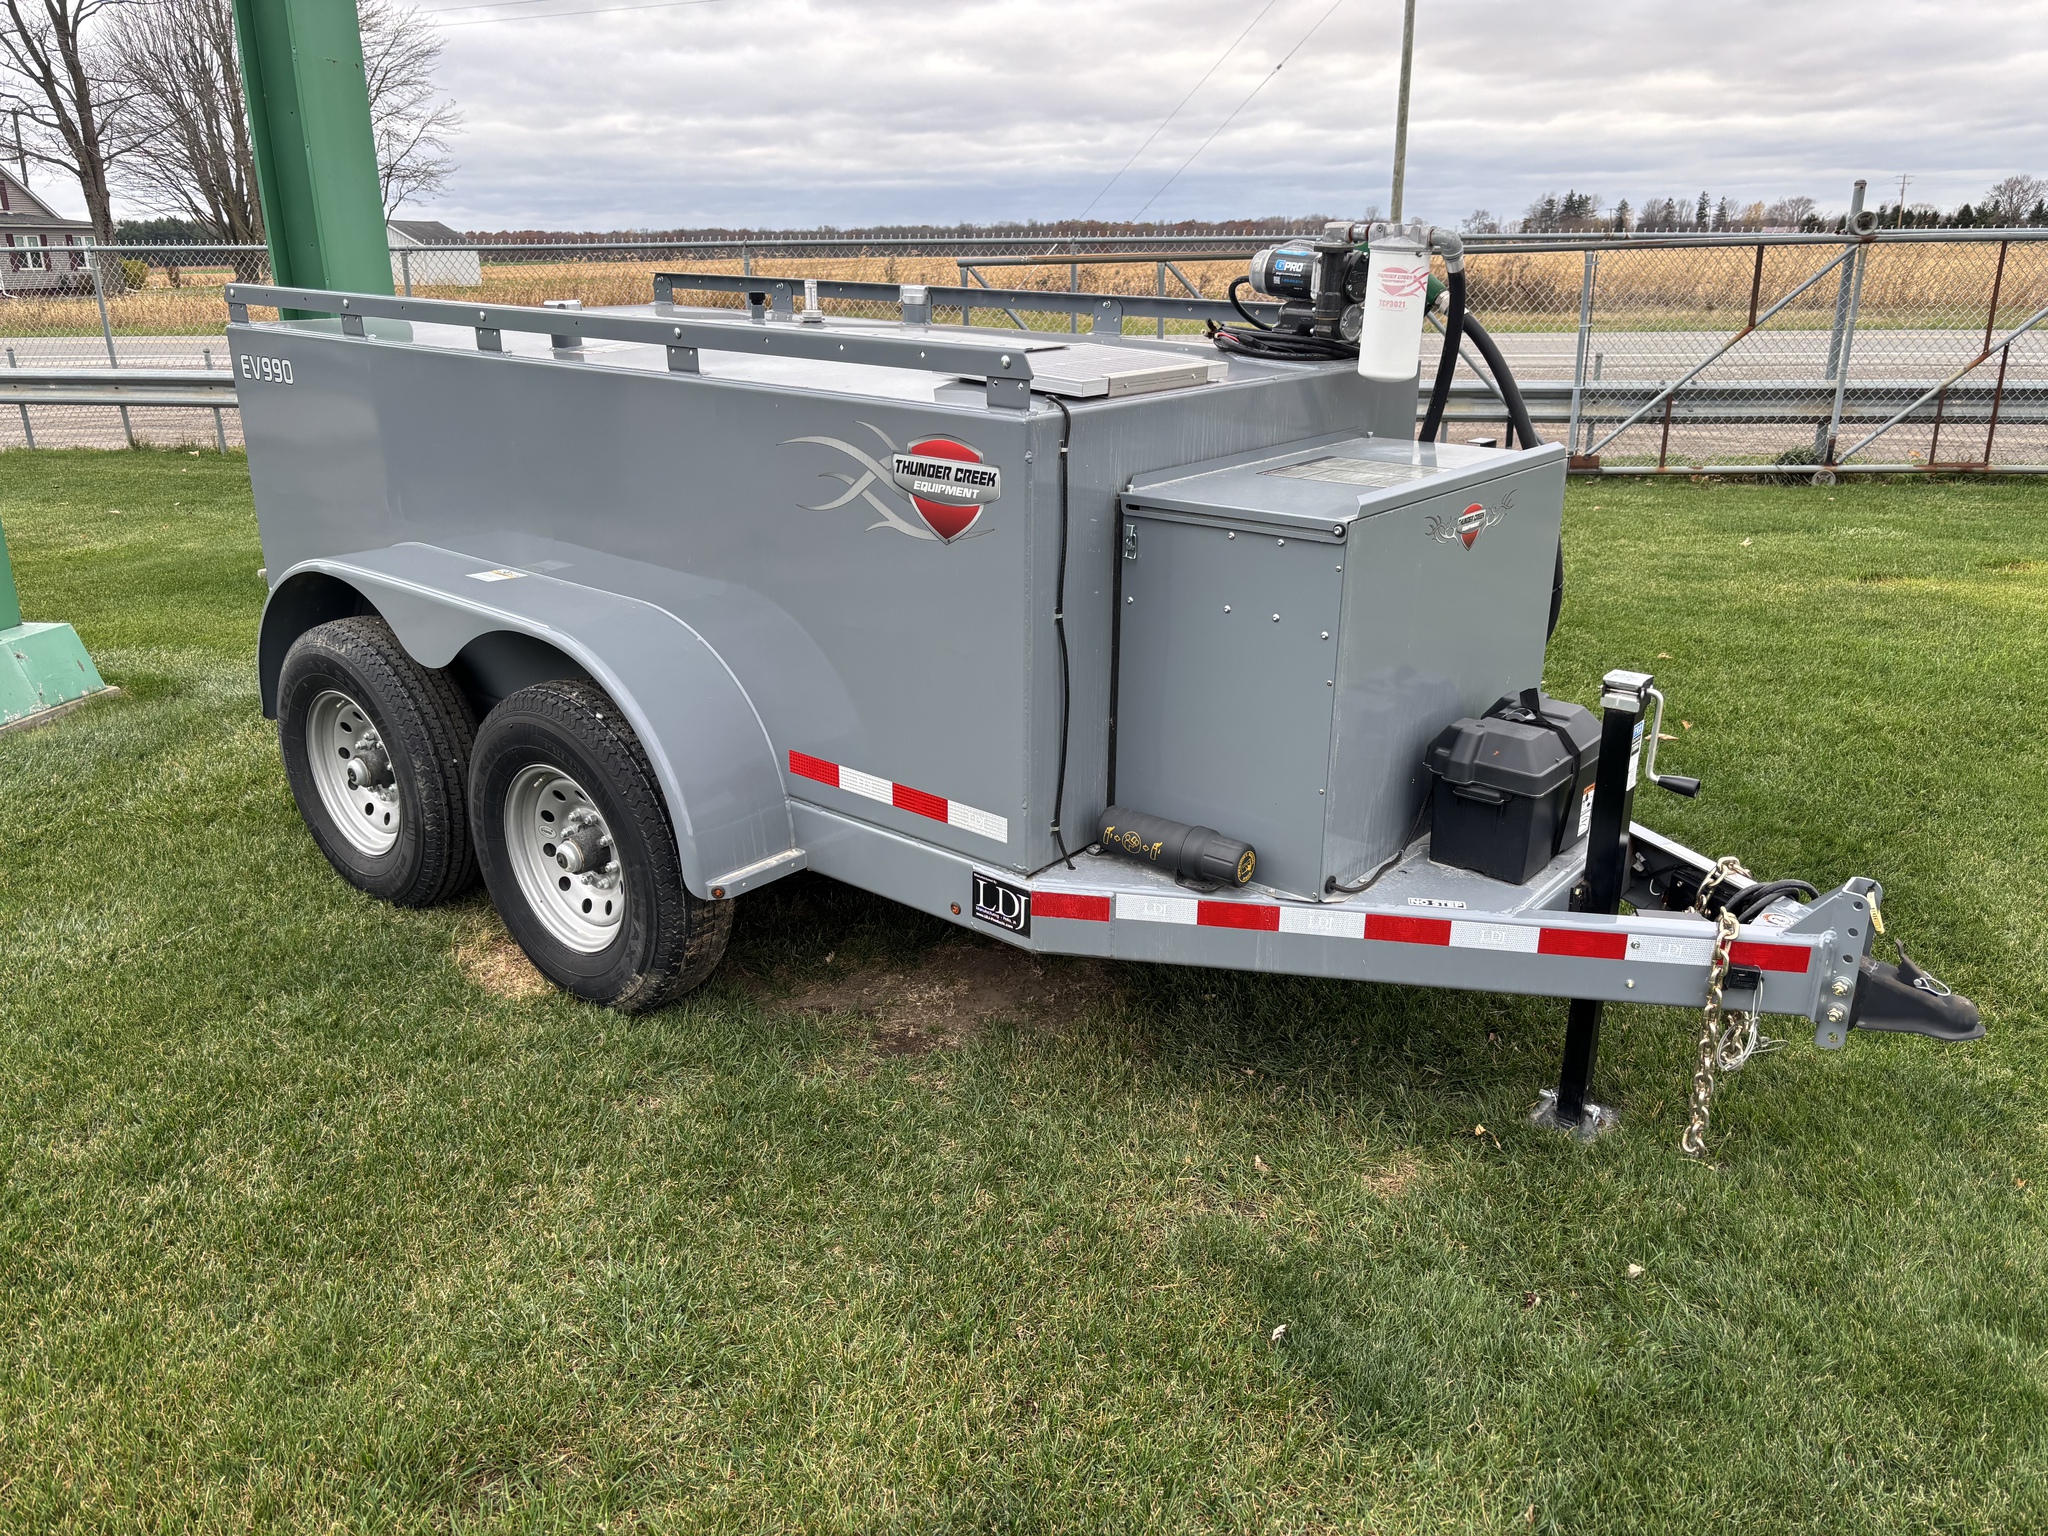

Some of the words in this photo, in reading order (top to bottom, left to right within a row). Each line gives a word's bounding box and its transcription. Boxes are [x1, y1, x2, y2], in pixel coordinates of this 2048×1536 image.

[1378, 299, 1406, 308] TCP3021
[240, 354, 294, 385] EV990
[895, 459, 952, 481] THUNDER
[954, 467, 997, 487] CREEK
[913, 480, 980, 499] EQUIPMENT
[975, 878, 1029, 930] LDJ
[1144, 902, 1167, 917] LDJ
[1309, 915, 1333, 931] LDJ
[1481, 929, 1505, 945] LDJ
[1658, 943, 1685, 959] LDJ
